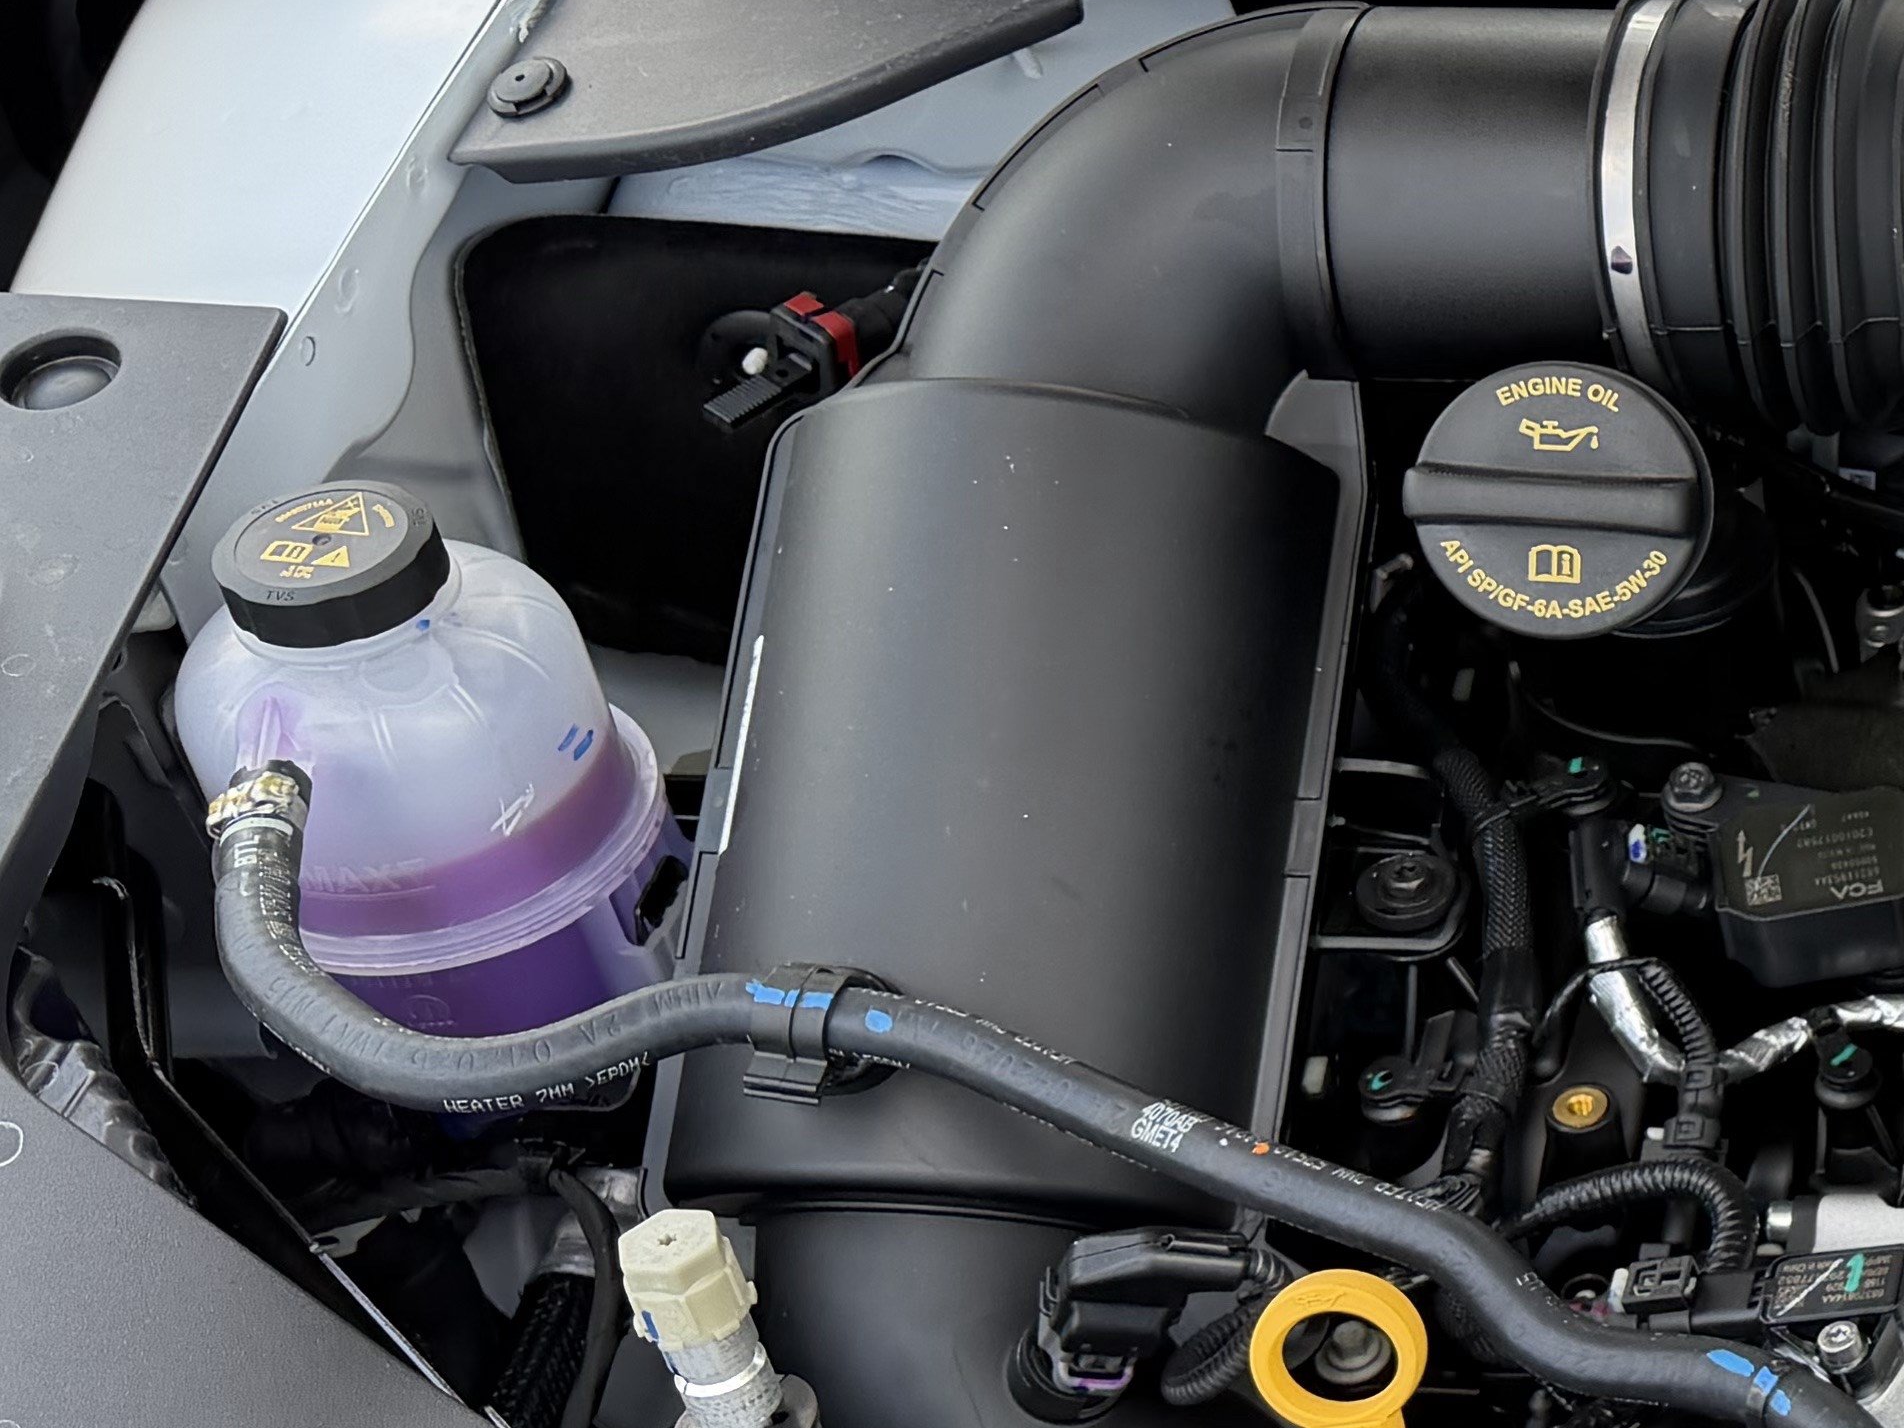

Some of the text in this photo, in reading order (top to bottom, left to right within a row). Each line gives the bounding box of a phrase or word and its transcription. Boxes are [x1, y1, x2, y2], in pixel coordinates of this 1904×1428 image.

[1496, 376, 1620, 412] ENGINE OIL
[264, 588, 296, 603] TVS
[1440, 539, 1669, 619] API SP/GF-6A-SAE-5W-30
[1829, 879, 1884, 900] FCA
[442, 1093, 525, 1115] HEATER
[536, 1082, 577, 1104] 7MM
[1131, 1117, 1184, 1154] GMET4
